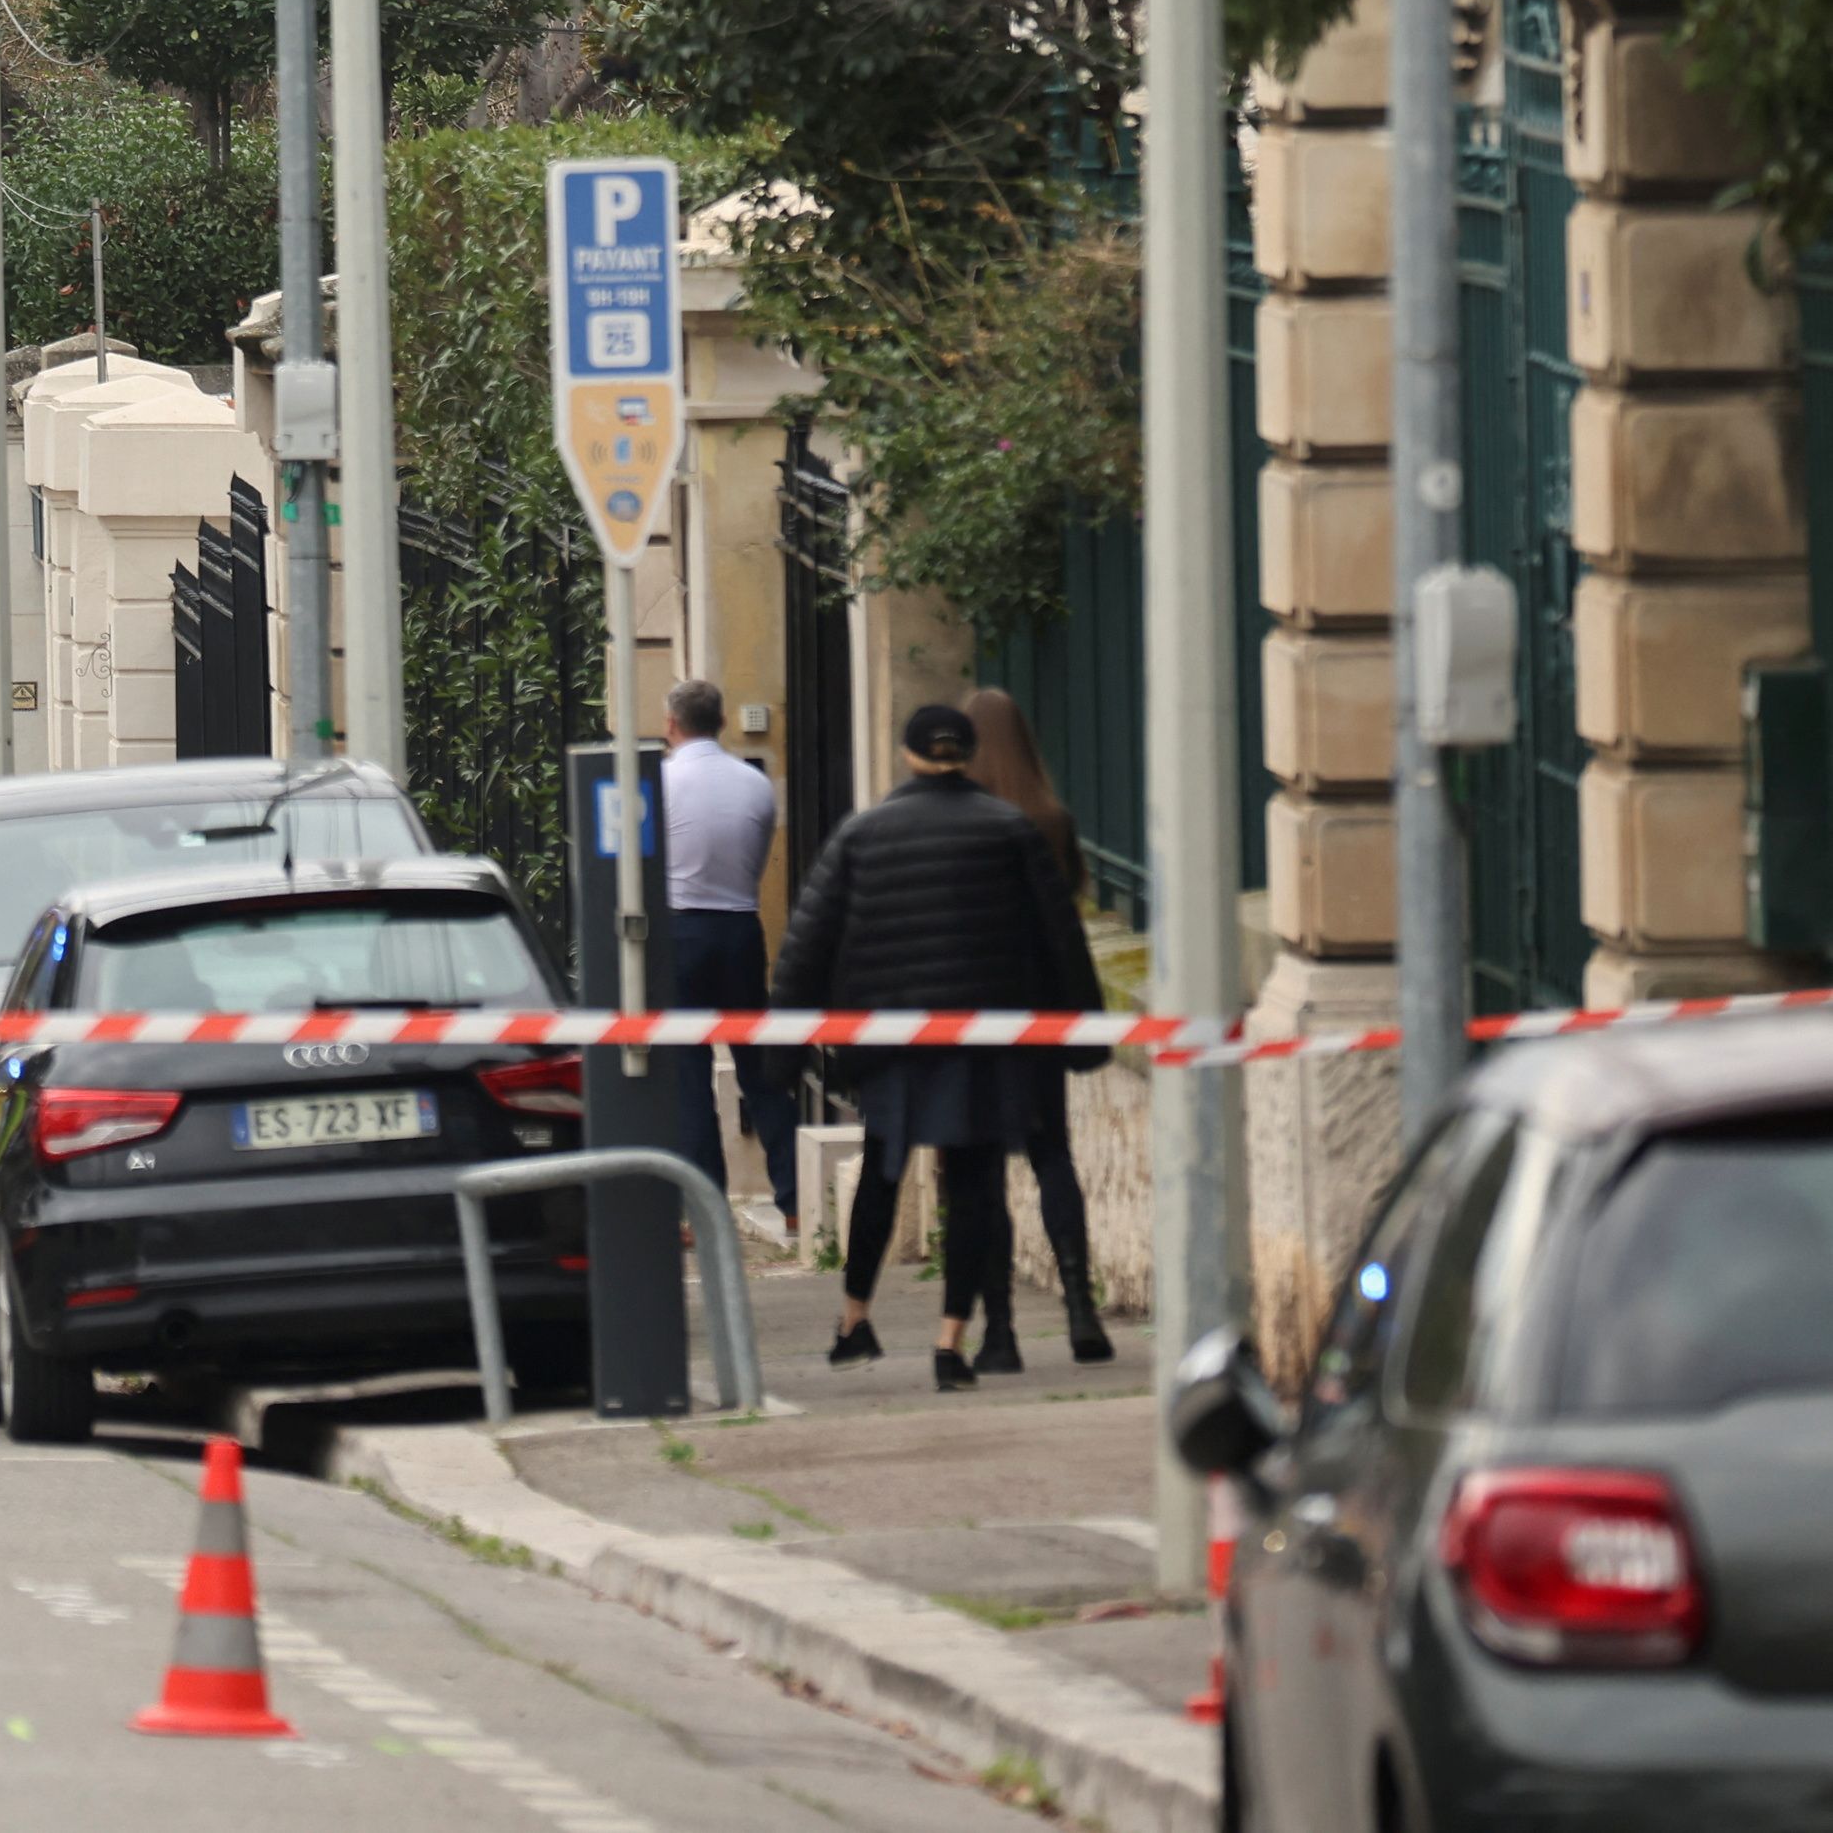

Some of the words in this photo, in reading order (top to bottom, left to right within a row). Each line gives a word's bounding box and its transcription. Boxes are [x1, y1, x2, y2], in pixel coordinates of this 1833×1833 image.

[593, 175, 642, 247] P
[574, 247, 662, 272] PAYANT
[254, 1096, 409, 1141] ES-723-XF
